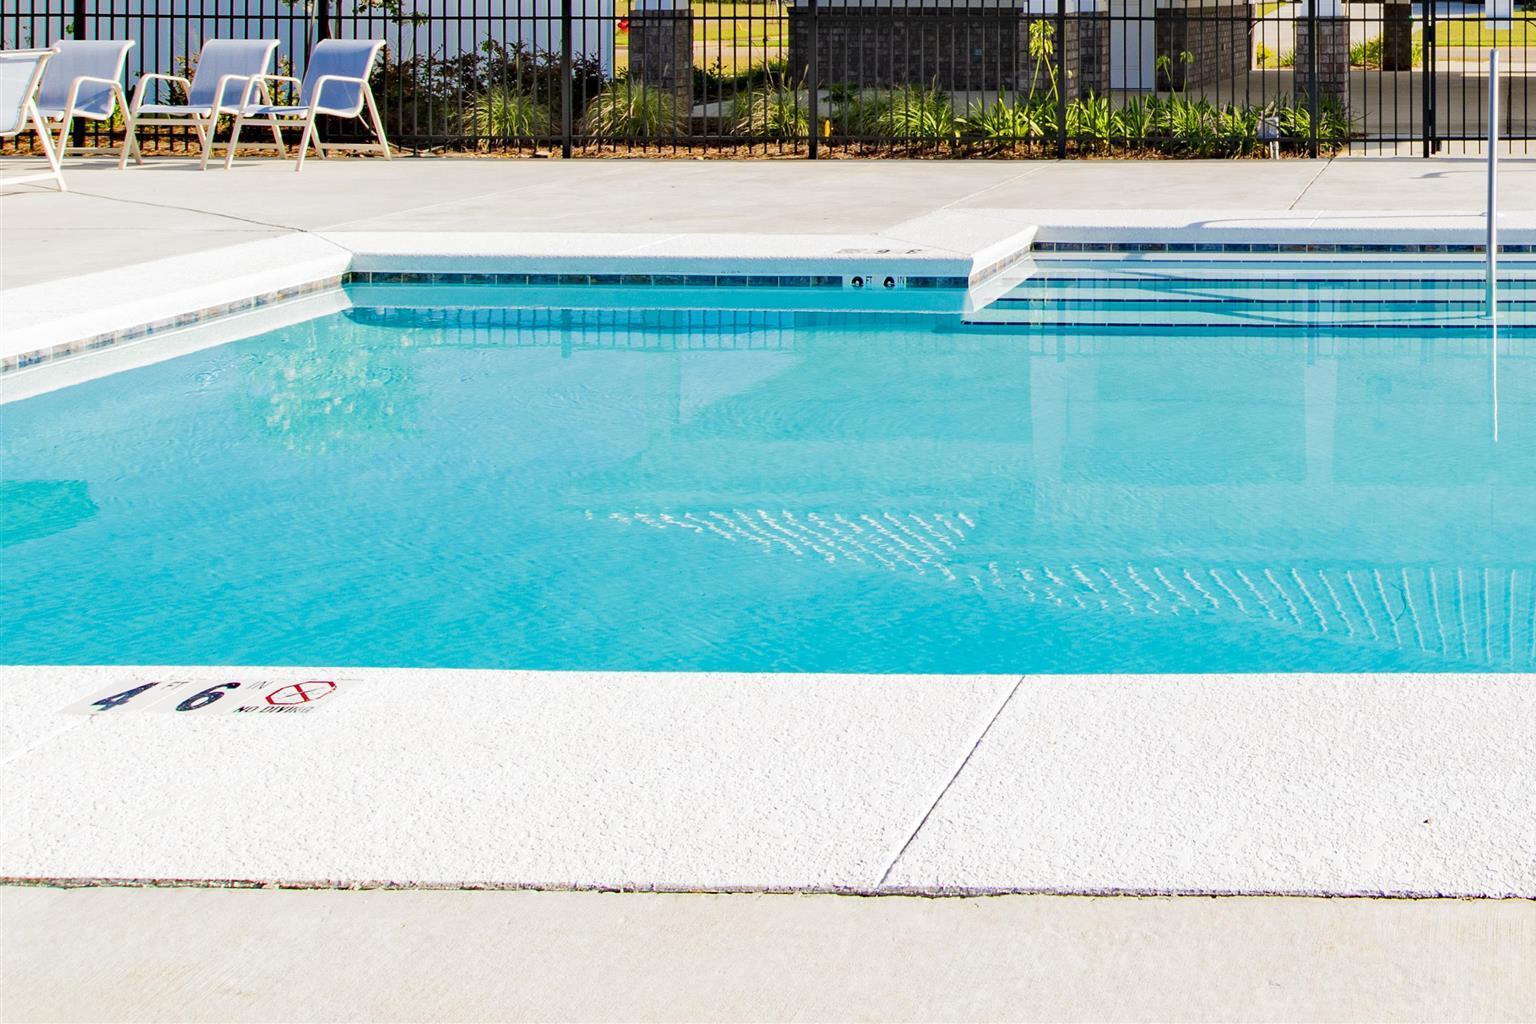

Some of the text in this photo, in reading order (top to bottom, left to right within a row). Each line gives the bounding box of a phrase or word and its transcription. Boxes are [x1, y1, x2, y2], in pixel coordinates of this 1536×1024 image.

[90, 681, 161, 712] 4
[175, 681, 242, 712] 6
[232, 705, 259, 714] NO
